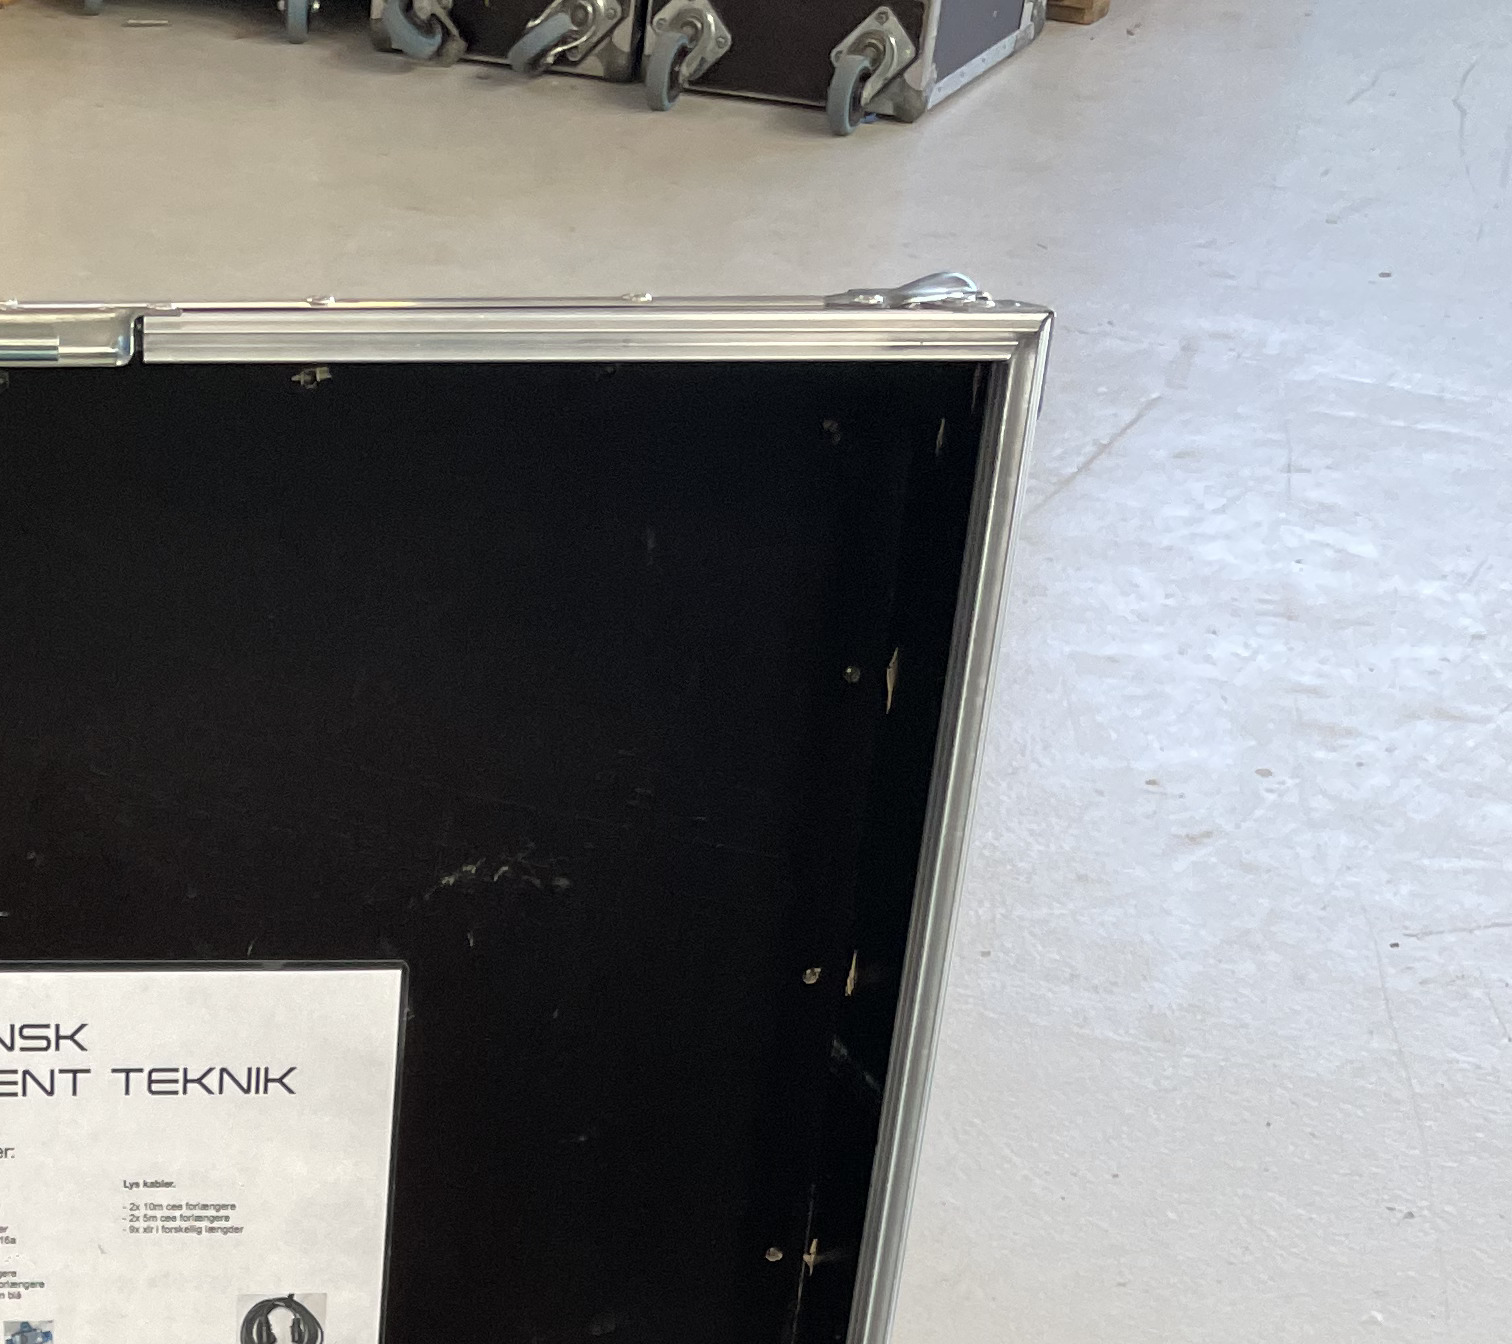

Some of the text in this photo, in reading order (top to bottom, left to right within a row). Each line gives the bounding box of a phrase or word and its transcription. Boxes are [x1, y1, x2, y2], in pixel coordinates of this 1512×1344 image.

[110, 1066, 297, 1096] TEKNIK
[123, 1180, 140, 1190] Lys
[129, 1202, 140, 1211] 2x
[144, 1202, 163, 1211] 10m
[129, 1214, 140, 1222] 2x
[142, 1214, 158, 1222] 5m
